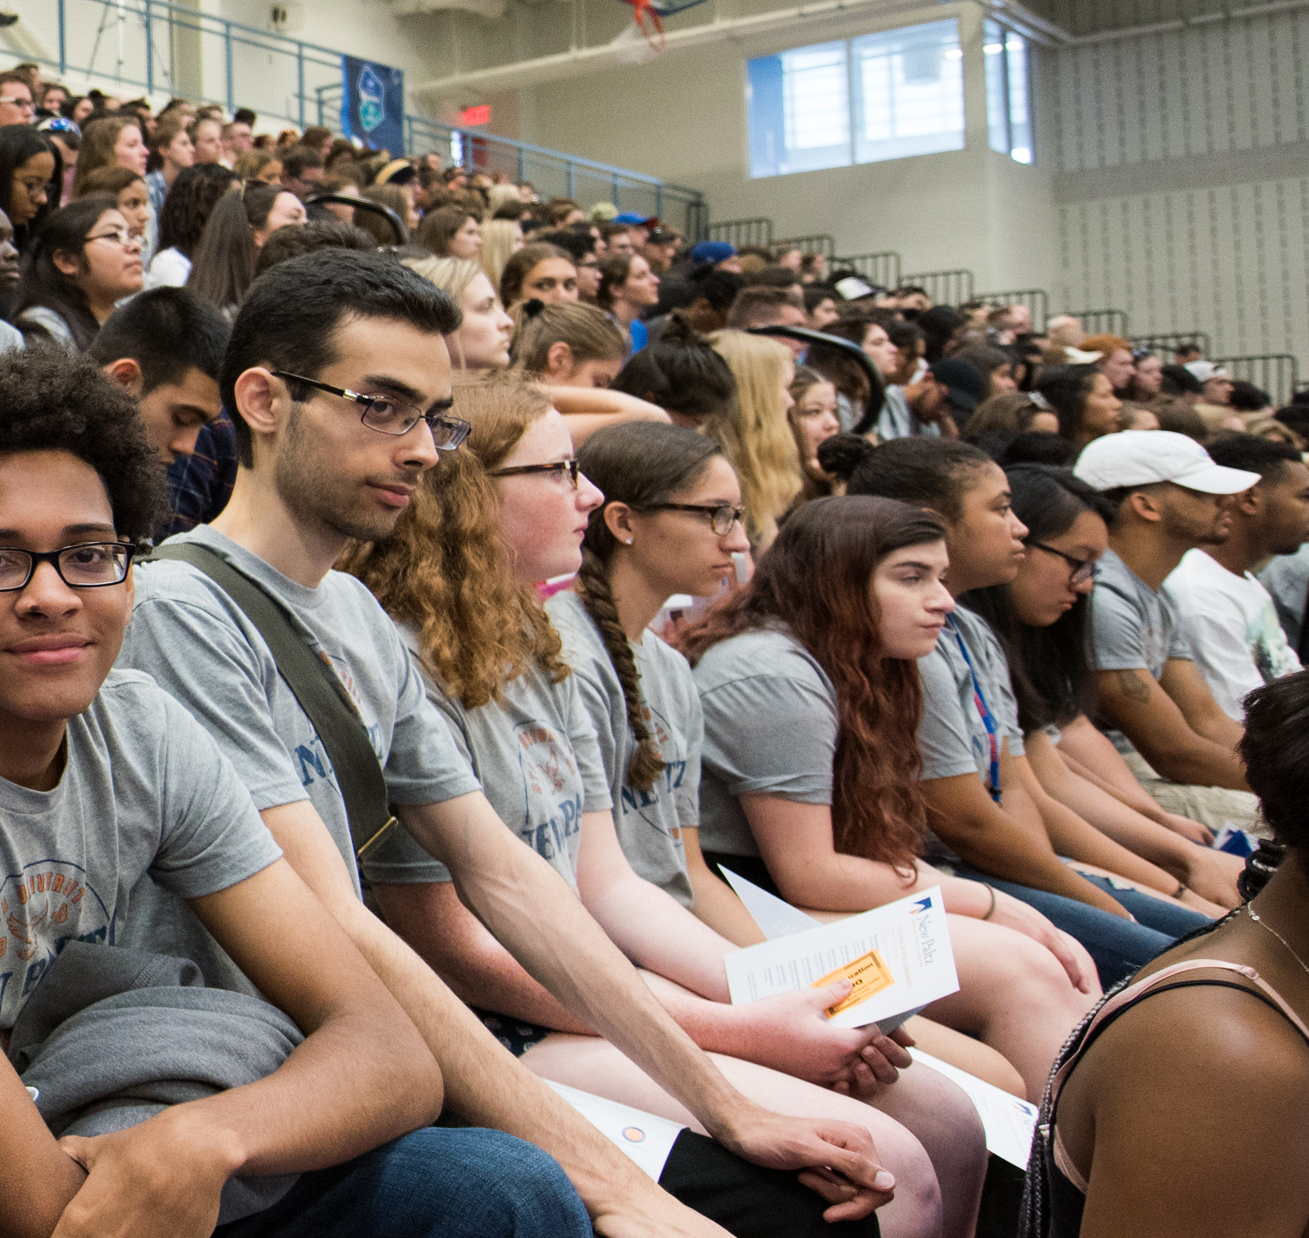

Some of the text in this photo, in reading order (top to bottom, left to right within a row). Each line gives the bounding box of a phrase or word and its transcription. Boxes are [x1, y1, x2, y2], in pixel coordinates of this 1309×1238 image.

[15, 872, 86, 905] UNIVERSIT
[916, 913, 932, 939] New
[921, 938, 937, 967] Paltz
